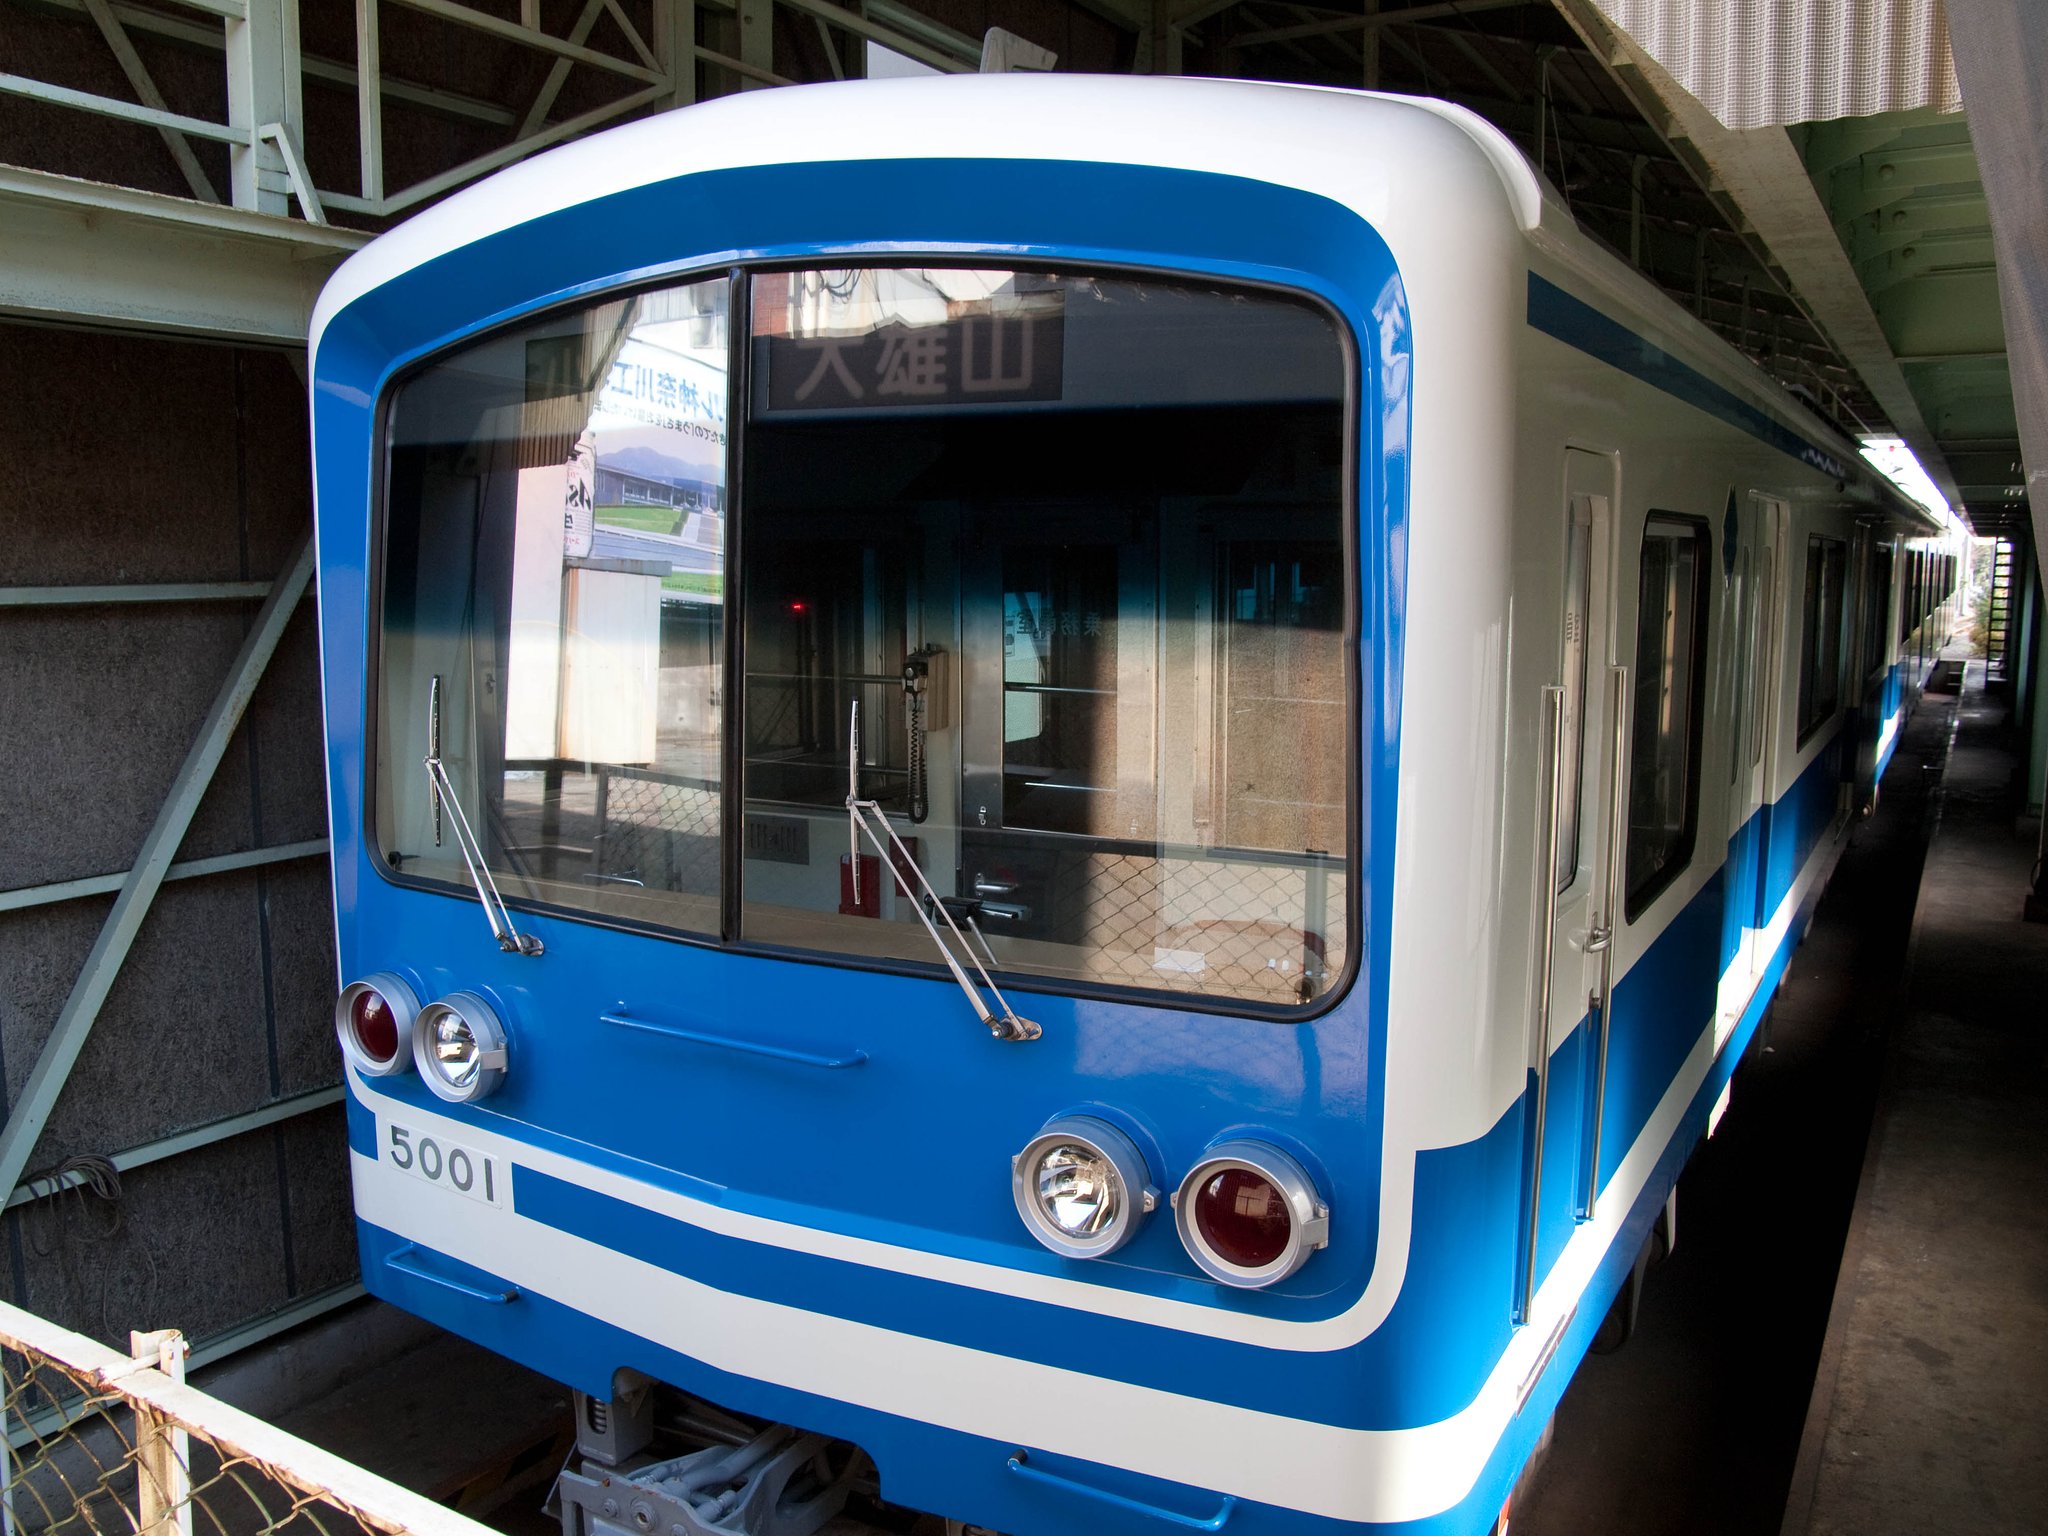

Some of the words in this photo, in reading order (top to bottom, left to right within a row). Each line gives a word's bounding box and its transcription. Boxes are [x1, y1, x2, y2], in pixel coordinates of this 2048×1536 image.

[794, 312, 1033, 400] 大雄山
[391, 1125, 493, 1202] 5001
